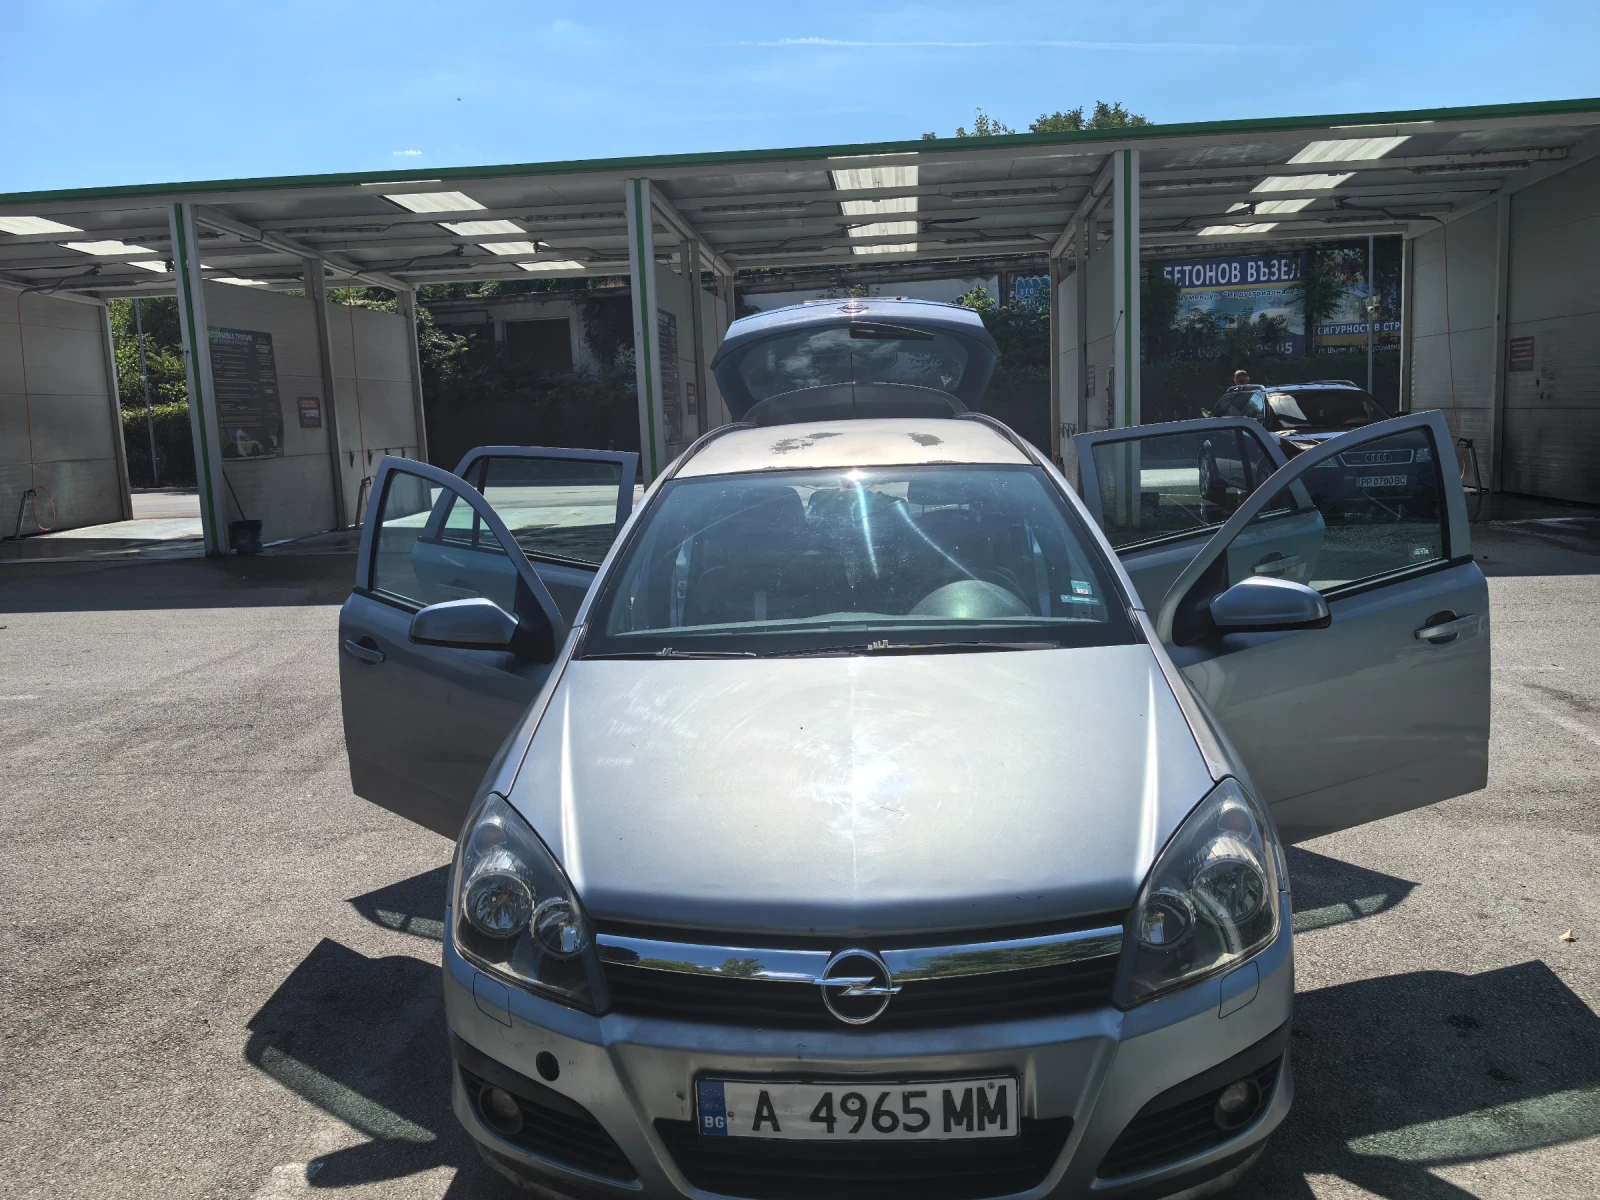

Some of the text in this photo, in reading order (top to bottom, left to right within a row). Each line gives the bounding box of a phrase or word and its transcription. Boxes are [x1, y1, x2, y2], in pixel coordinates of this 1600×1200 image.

[1163, 263, 1241, 286] БЕТОНОВ
[1317, 321, 1401, 335] СИГУРНОСТ В СТР
[1361, 477, 1372, 486] PP
[1373, 477, 1394, 486] 0700
[752, 1085, 1008, 1134] A 4965 MM
[704, 1115, 725, 1129] BG
